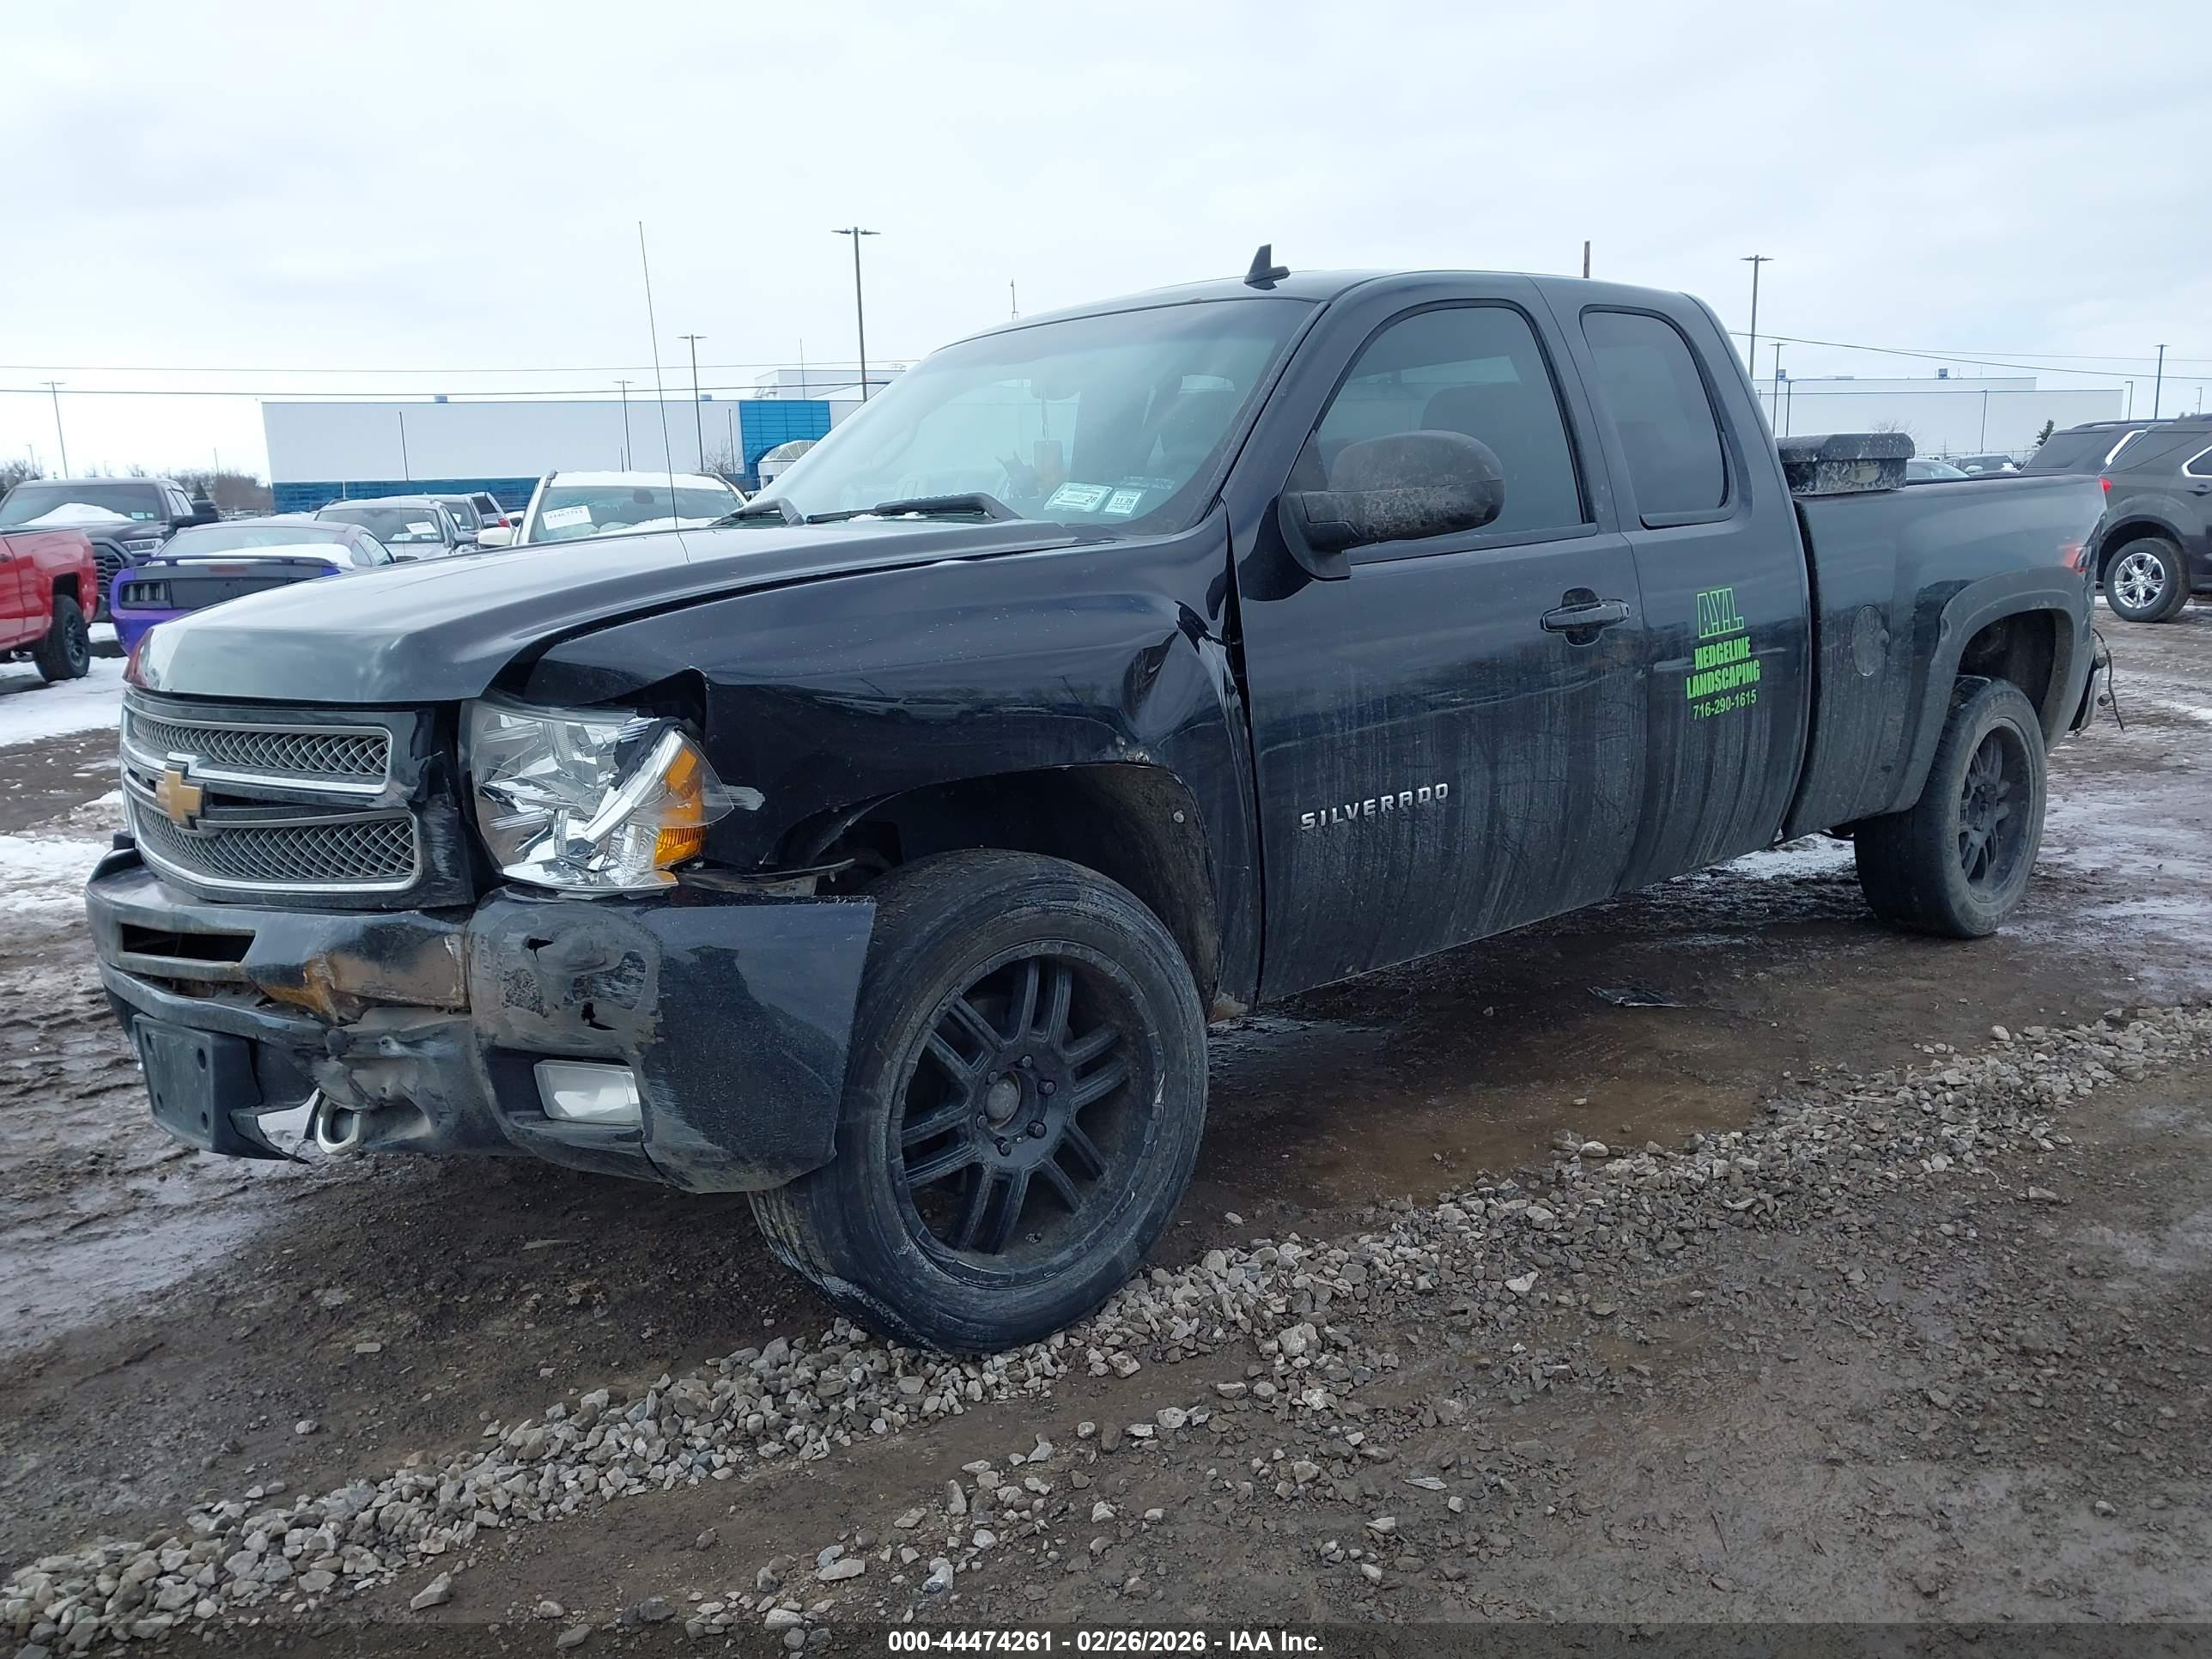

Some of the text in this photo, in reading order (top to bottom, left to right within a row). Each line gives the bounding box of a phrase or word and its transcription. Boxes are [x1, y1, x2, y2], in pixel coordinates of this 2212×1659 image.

[1694, 636, 1751, 670] HEDGELINE
[1686, 659, 1760, 700] LANDSCAPING
[1692, 689, 1757, 720] 716-290-1615
[1301, 782, 1449, 830] SILVERADO
